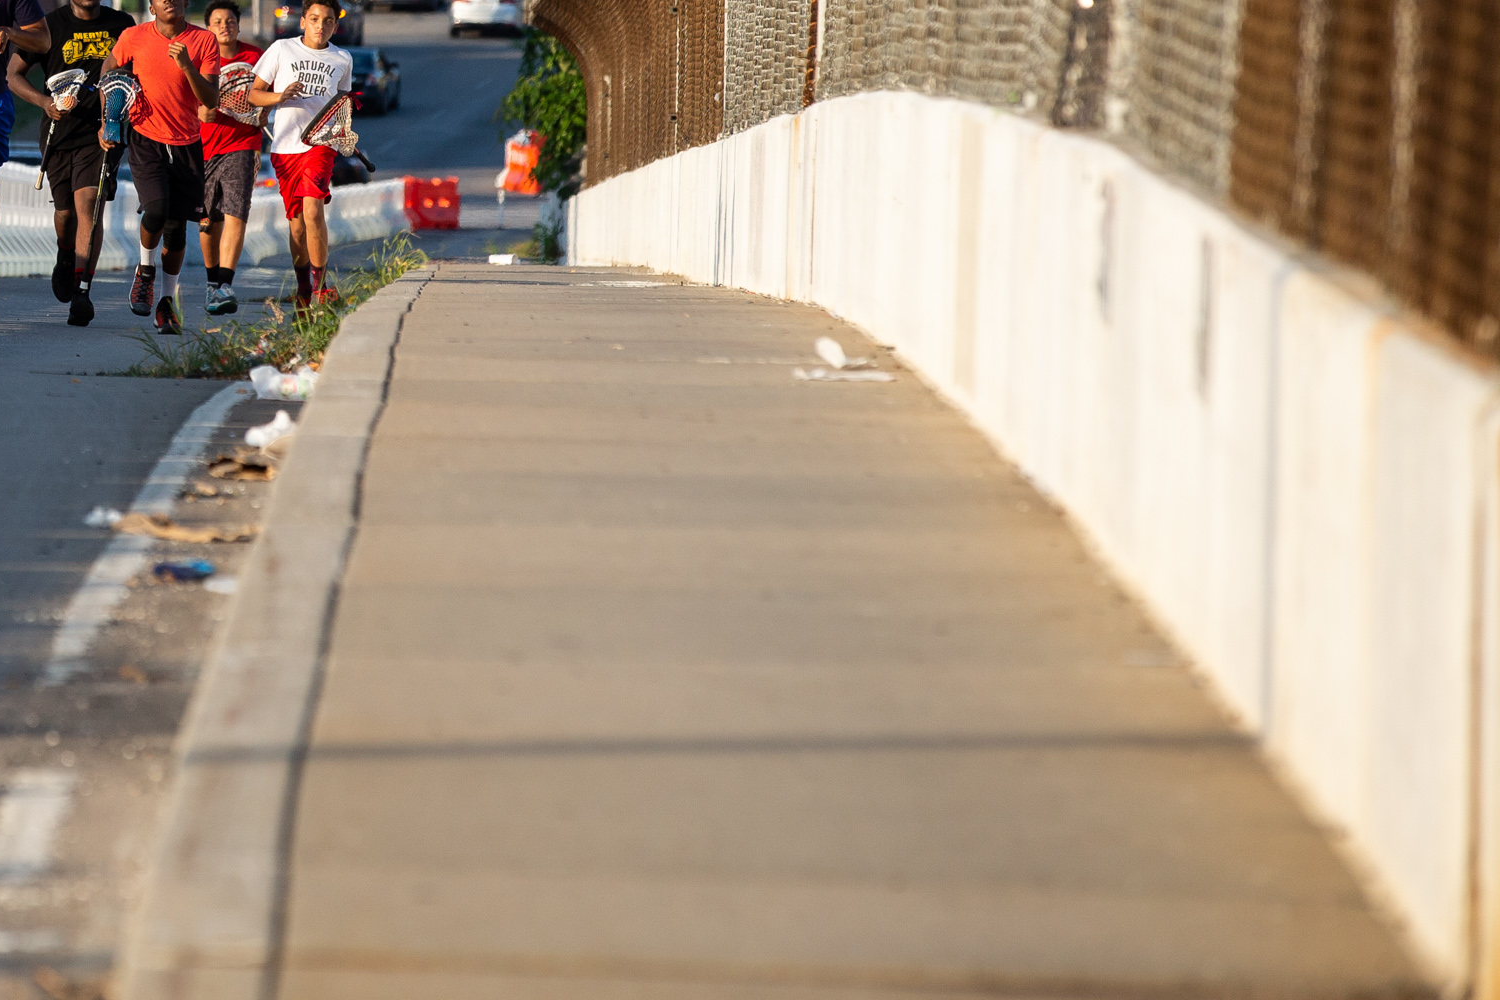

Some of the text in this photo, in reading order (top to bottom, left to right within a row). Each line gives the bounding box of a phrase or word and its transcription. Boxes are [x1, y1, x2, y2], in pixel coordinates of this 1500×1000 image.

[73, 31, 109, 40] MERVO
[291, 60, 336, 78] NATURAL
[298, 72, 325, 85] BORN
